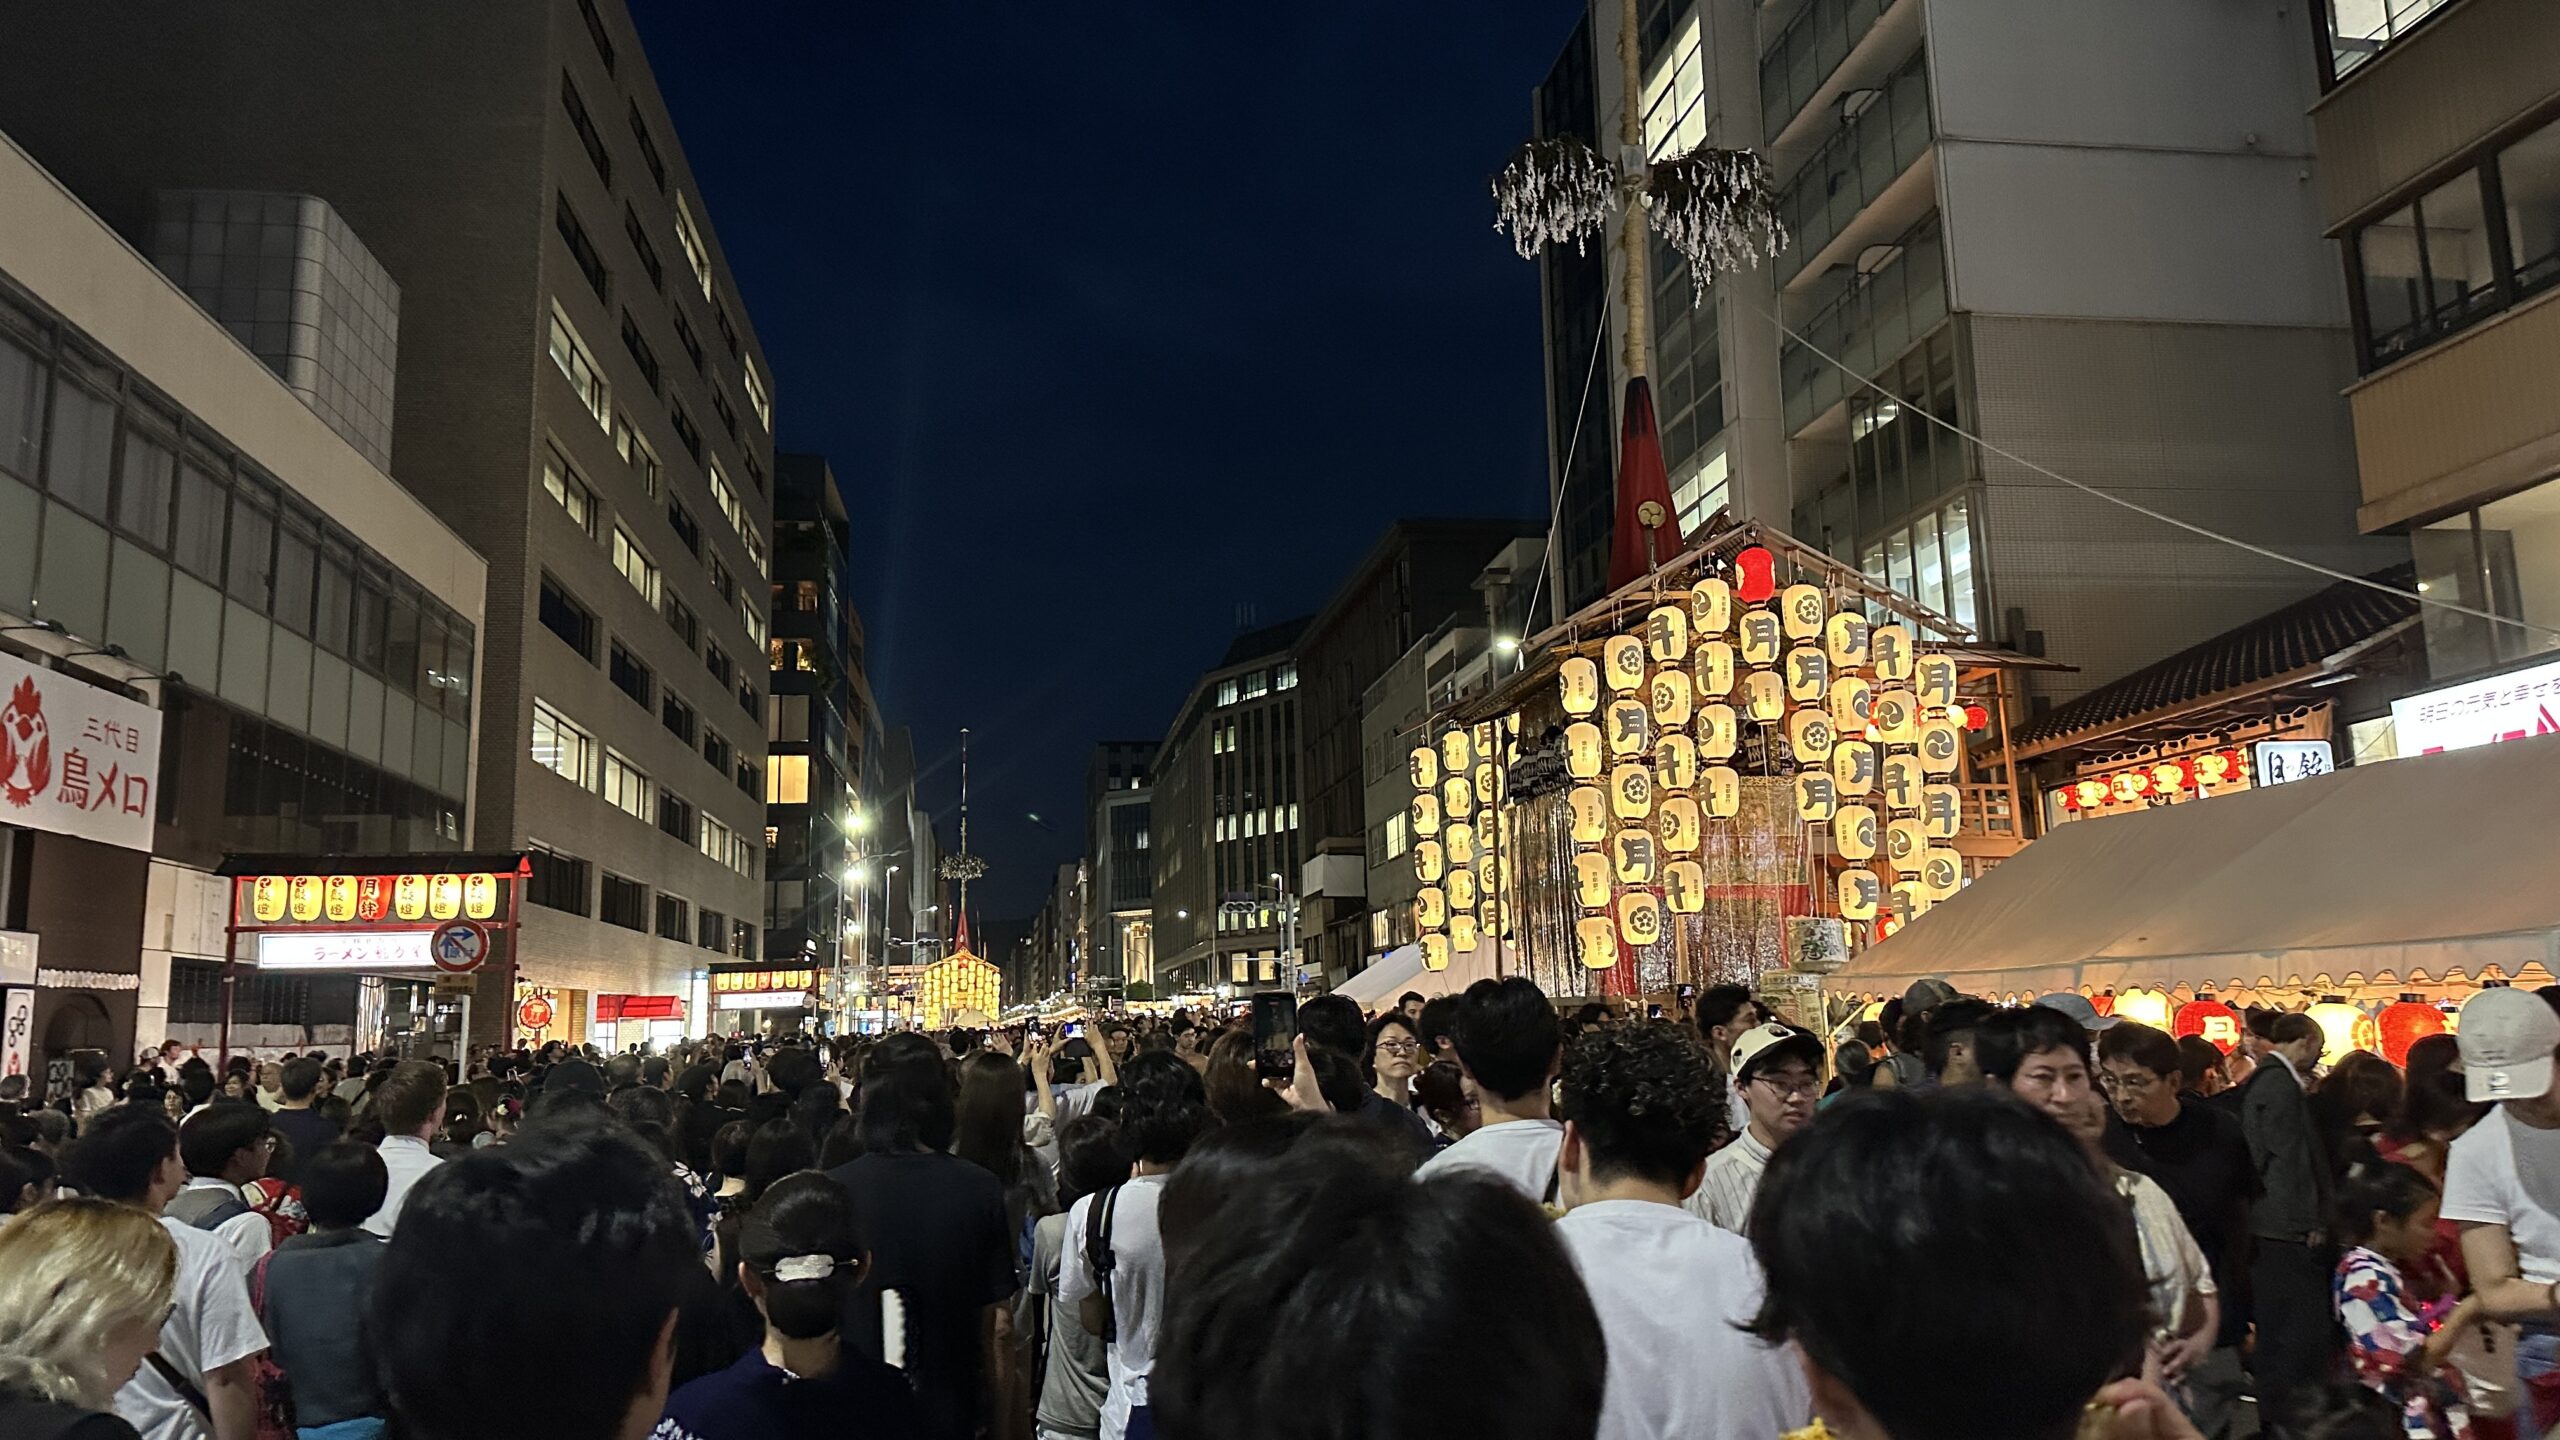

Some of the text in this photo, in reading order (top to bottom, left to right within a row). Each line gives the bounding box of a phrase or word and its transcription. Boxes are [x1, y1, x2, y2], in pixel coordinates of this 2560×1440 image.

[82, 717, 140, 754] 三代目
[56, 746, 149, 819] 鳥メロ
[314, 946, 368, 961] ラーメン
